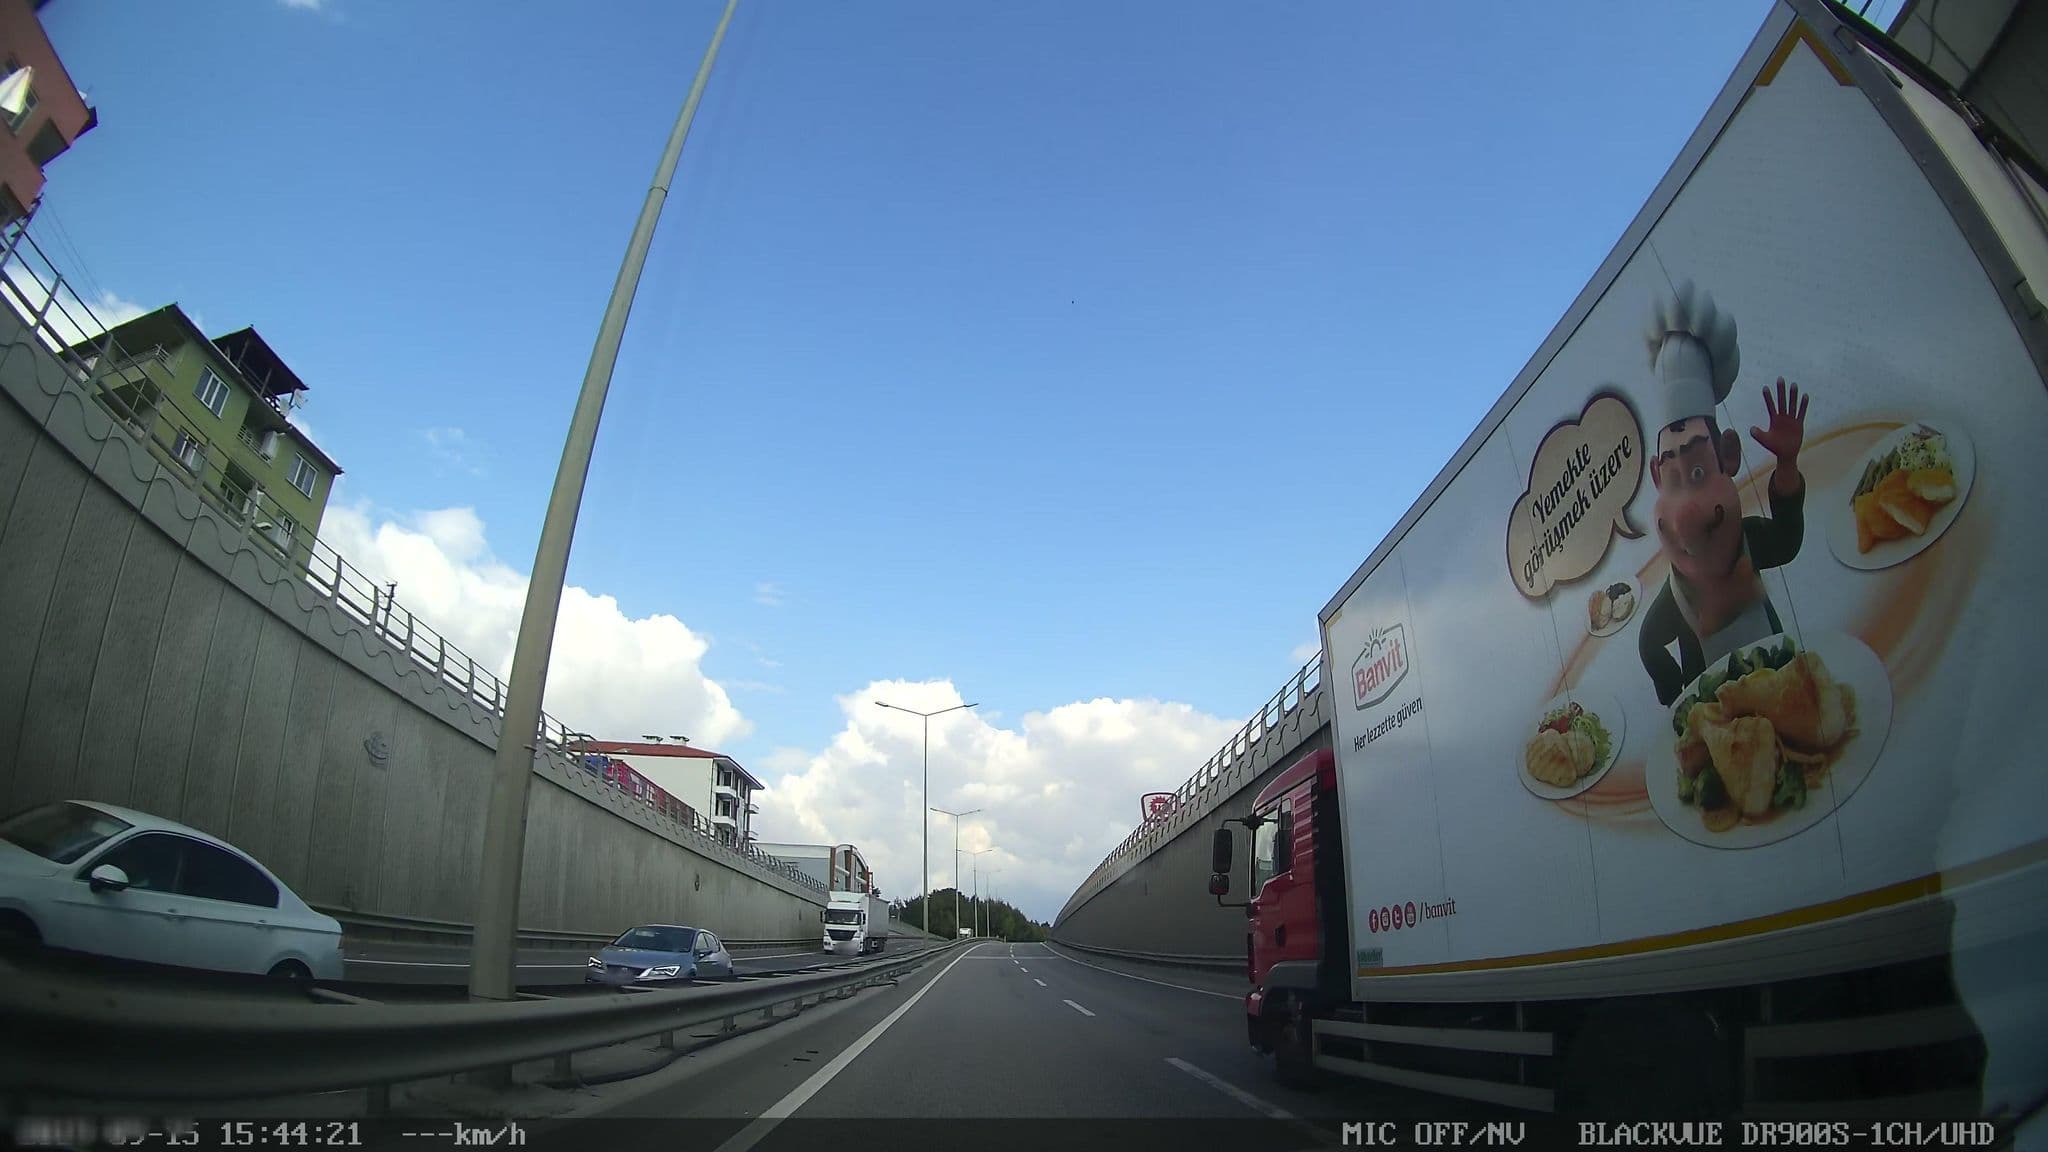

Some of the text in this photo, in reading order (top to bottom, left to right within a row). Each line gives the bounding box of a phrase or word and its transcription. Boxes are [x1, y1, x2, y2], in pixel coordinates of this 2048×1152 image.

[1523, 435, 1632, 588] görüşmek üzere
[1532, 443, 1591, 524] Yemekte
[1355, 638, 1403, 700] Banvit
[1354, 697, 1423, 752] Her lezzette güven
